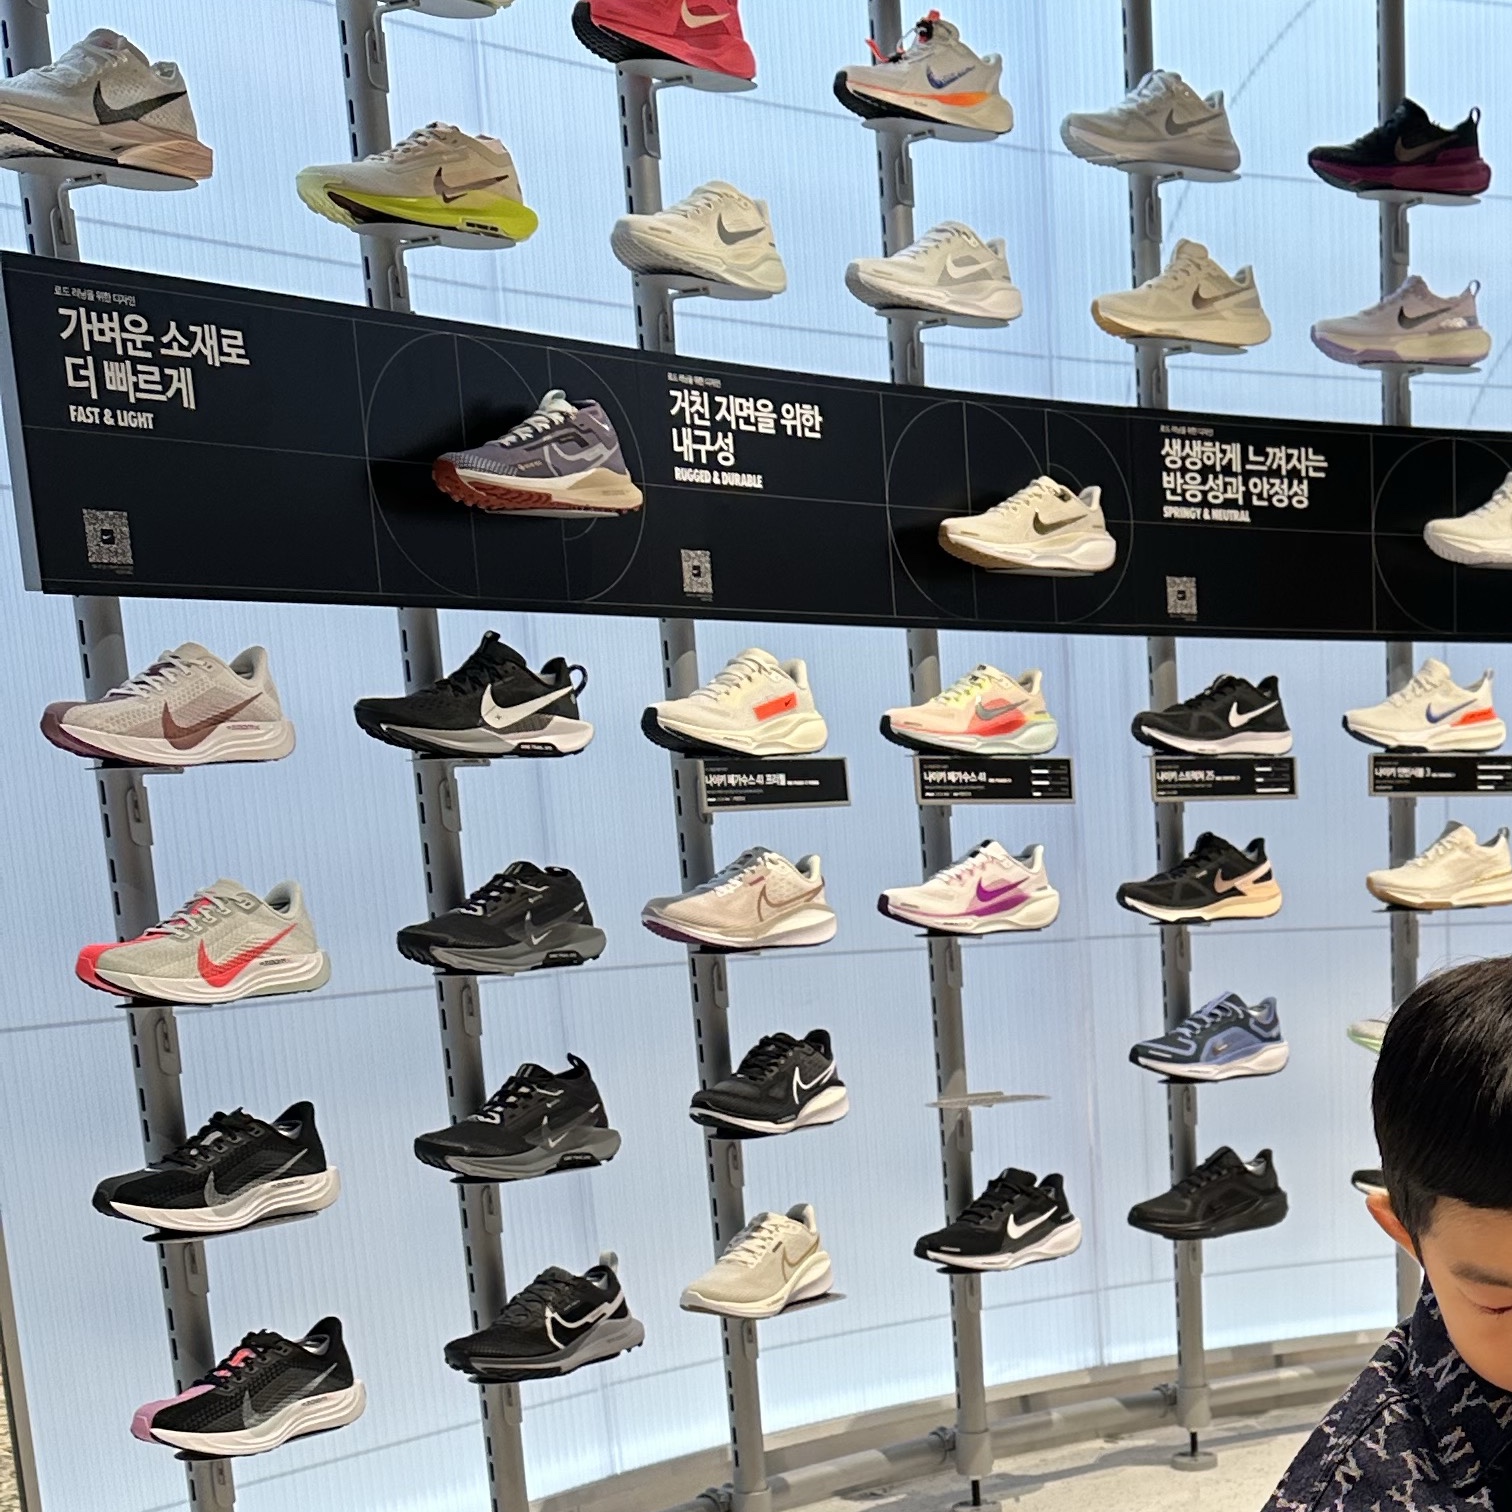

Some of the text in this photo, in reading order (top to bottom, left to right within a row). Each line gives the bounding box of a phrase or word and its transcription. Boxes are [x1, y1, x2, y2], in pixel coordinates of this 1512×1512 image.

[112, 293, 136, 307] 디자인
[58, 307, 250, 367] 가벼운 소재로
[65, 355, 196, 410] 더 빠르게
[69, 404, 154, 429] FAST & LIGHT
[669, 388, 823, 439] 거친 지면을 위한
[671, 427, 736, 467] 내구성
[1160, 438, 1328, 478] 생생하게 느껴지는
[674, 466, 764, 489] RUGGED & DURABLE
[1162, 471, 1309, 509] 반응성과 안정성
[1163, 505, 1202, 520] SPRINGY
[1211, 508, 1251, 523] NEUTRAL
